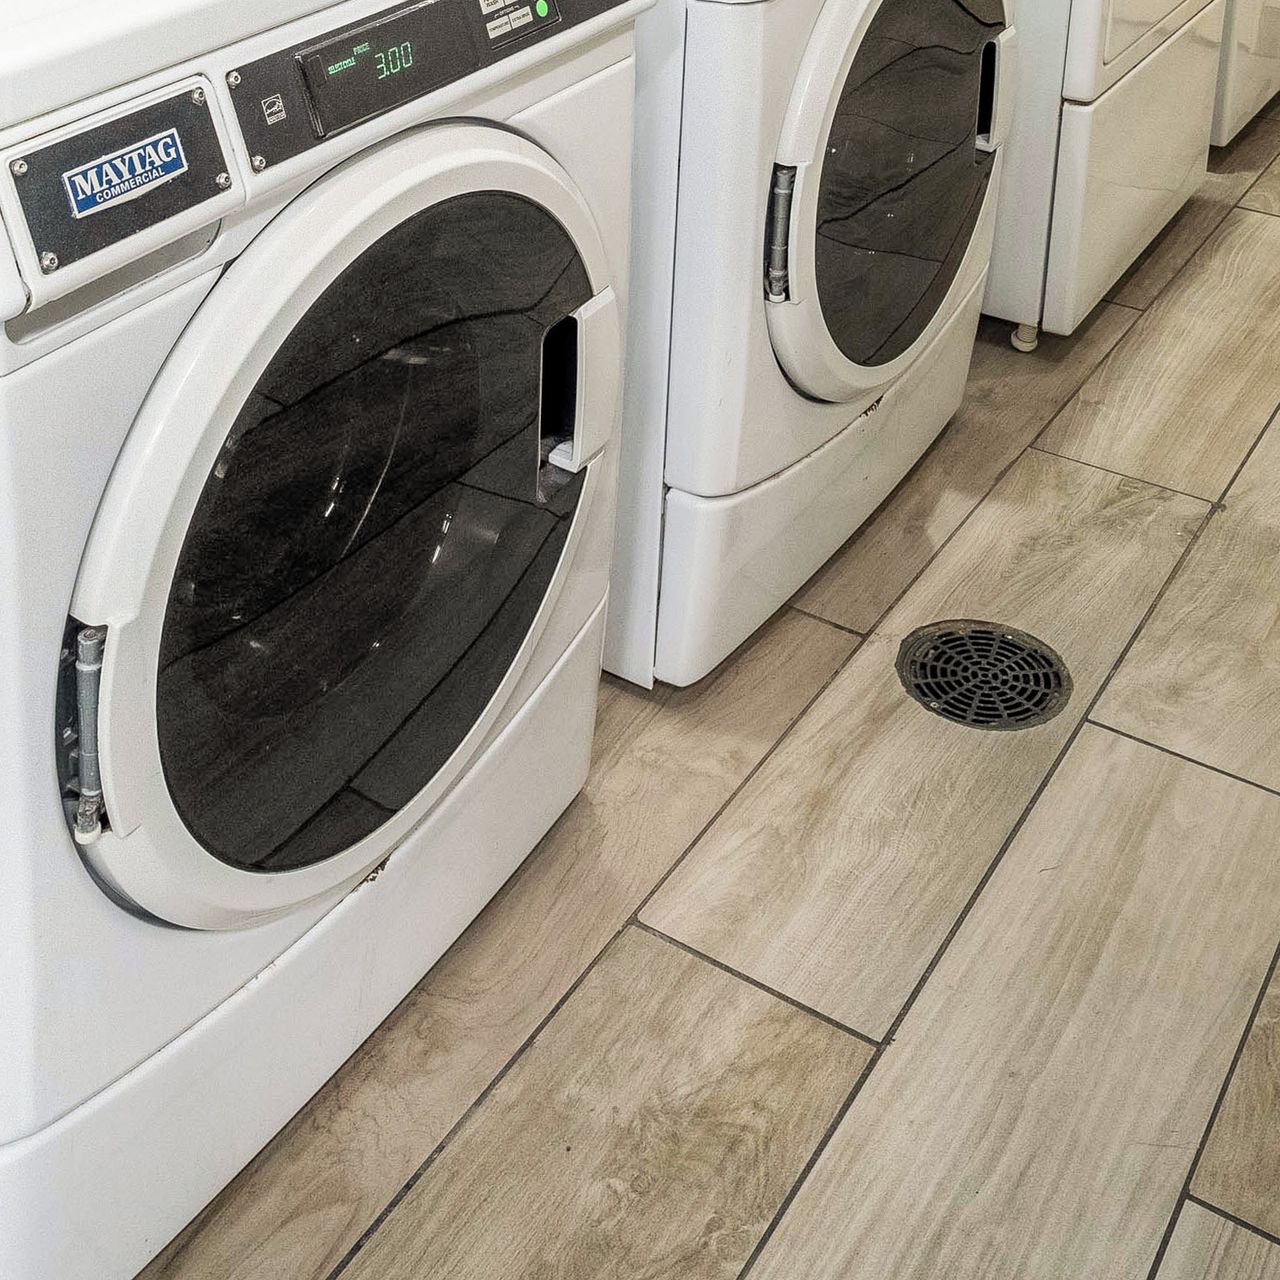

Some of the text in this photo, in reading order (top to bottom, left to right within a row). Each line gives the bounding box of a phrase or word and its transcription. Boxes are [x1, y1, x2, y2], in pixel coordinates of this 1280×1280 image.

[374, 41, 413, 79] 3.00
[71, 137, 177, 200] MAYTAG
[96, 167, 165, 203] COMMERCIAL
